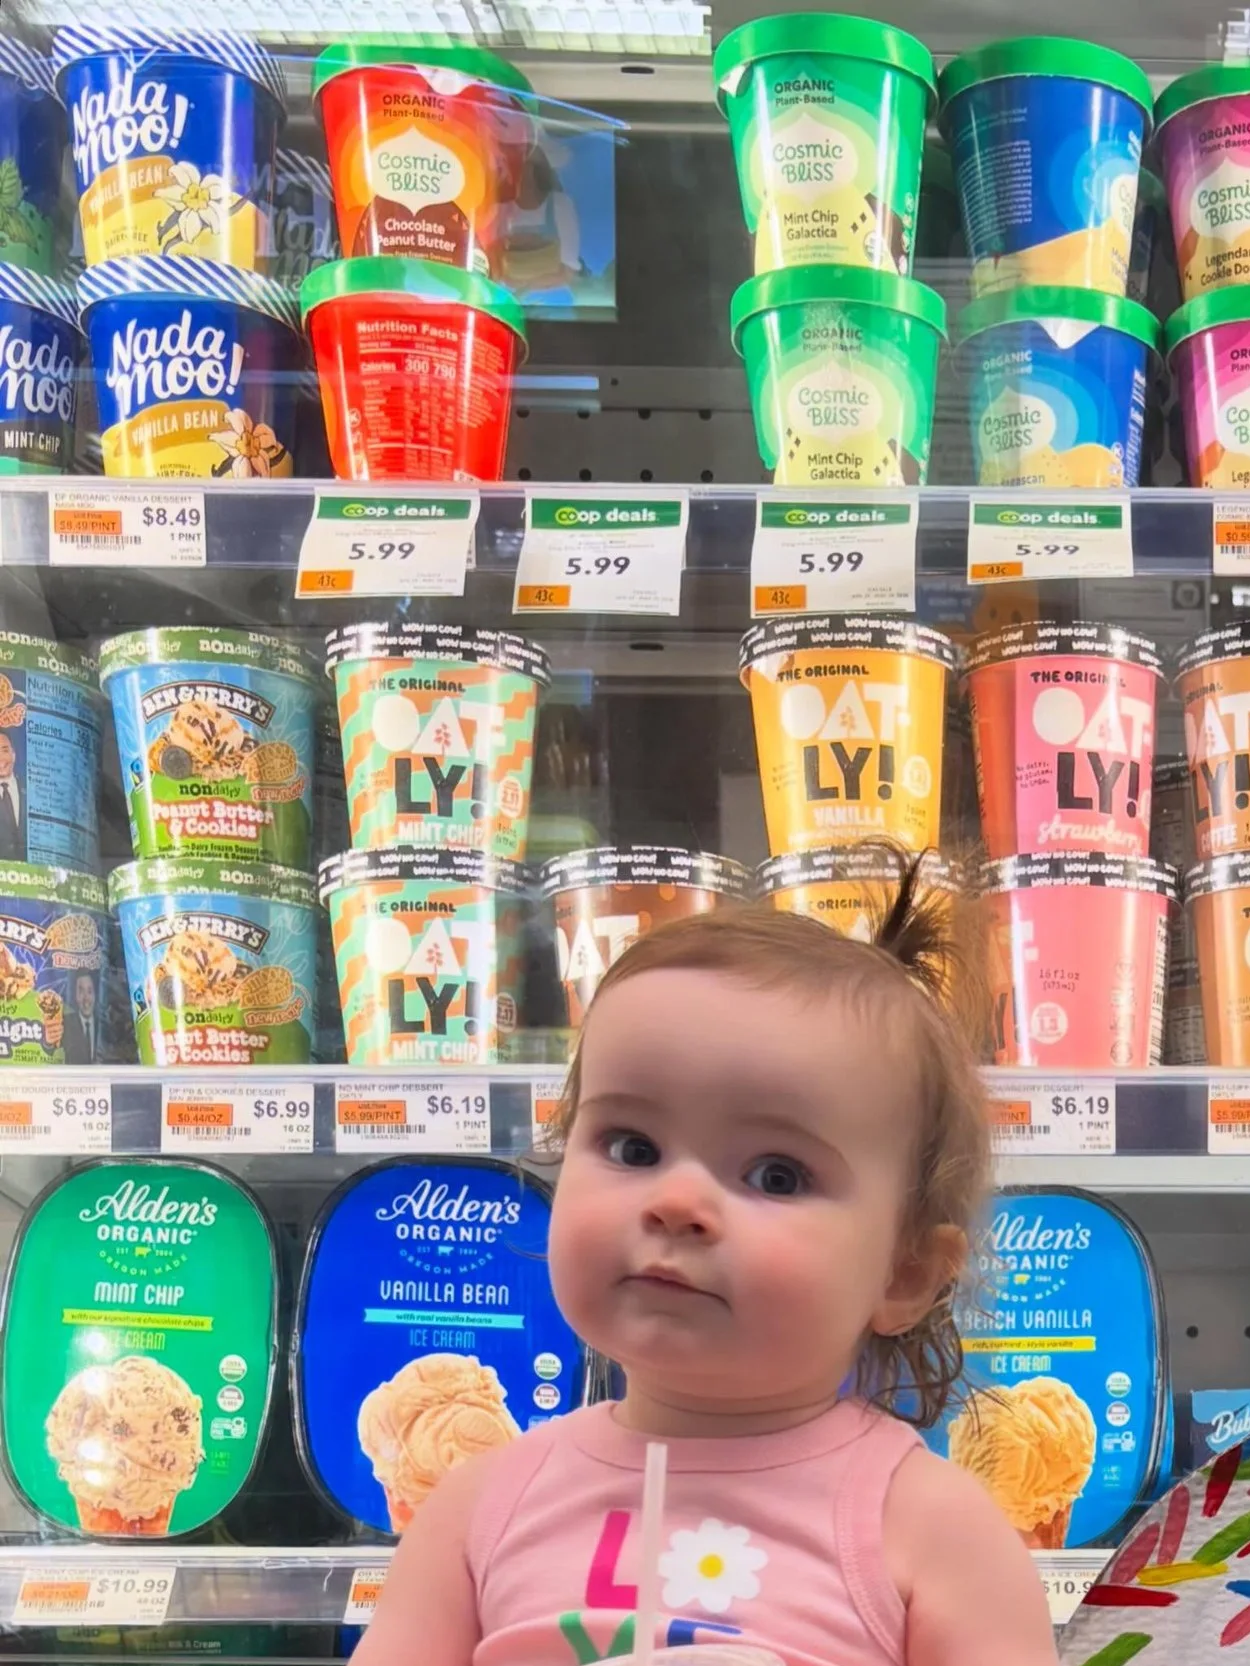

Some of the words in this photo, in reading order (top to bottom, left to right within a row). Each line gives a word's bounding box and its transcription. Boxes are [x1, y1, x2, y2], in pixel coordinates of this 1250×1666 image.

[73, 69, 169, 138] Nada
[74, 93, 190, 187] moo!
[773, 139, 843, 162] Cosmic
[377, 152, 451, 175] Cosmic
[384, 217, 446, 234] Chocolate
[784, 211, 808, 226] Mint
[810, 209, 839, 227] Chip
[417, 233, 456, 252] Butter
[786, 225, 838, 241] Galactica
[357, 320, 418, 334] Nutrition
[105, 309, 227, 388] Nada
[116, 342, 245, 416] moo!
[433, 362, 457, 381] 790
[798, 385, 869, 406] Cosmic
[183, 408, 219, 430] BEAN
[982, 404, 1042, 436] Cosmic
[4, 430, 34, 449] MINT
[807, 453, 833, 467] Mint
[835, 451, 864, 467] Chip
[810, 465, 862, 481] Galactica
[143, 506, 201, 527] $8.49
[348, 541, 416, 561] 5.99
[1016, 543, 1080, 556] 5.99
[565, 556, 631, 576] 5.99
[799, 551, 864, 574] 5.99
[777, 670, 801, 682] THE
[804, 664, 870, 677] ORIGINAL
[1030, 671, 1061, 684] THE
[399, 677, 467, 693] ORIGINAL
[803, 741, 896, 802] LY!
[179, 782, 241, 799] nondairy
[394, 756, 489, 820] LY!
[1056, 751, 1141, 818] LY!
[213, 800, 274, 825] Butter
[812, 804, 886, 828] VANILLA
[185, 817, 258, 839] Cookies
[398, 821, 444, 843] MINT
[390, 900, 458, 914] ORIGINAL
[387, 976, 480, 1037] LY!
[208, 1029, 270, 1048] Butter
[179, 1045, 252, 1065] Cookies
[391, 1040, 439, 1061] MINT
[52, 1098, 110, 1117] $6.99
[253, 1100, 311, 1119] $6.99
[427, 1095, 487, 1116] $6.19
[1051, 1095, 1110, 1116] $6.19
[78, 1179, 218, 1226] Alden's
[375, 1179, 522, 1225] Alden's
[93, 1281, 138, 1303] MINT
[143, 1284, 185, 1306] CHIP
[380, 1280, 455, 1303] VANILLA
[462, 1283, 510, 1306] BEAN
[1023, 1309, 1094, 1329] VANILLA
[408, 1328, 429, 1348] ICE
[432, 1329, 477, 1350] CREAM
[990, 1355, 1007, 1372] ICE
[1011, 1355, 1052, 1372] CREAM
[97, 1577, 169, 1595] $10.99
